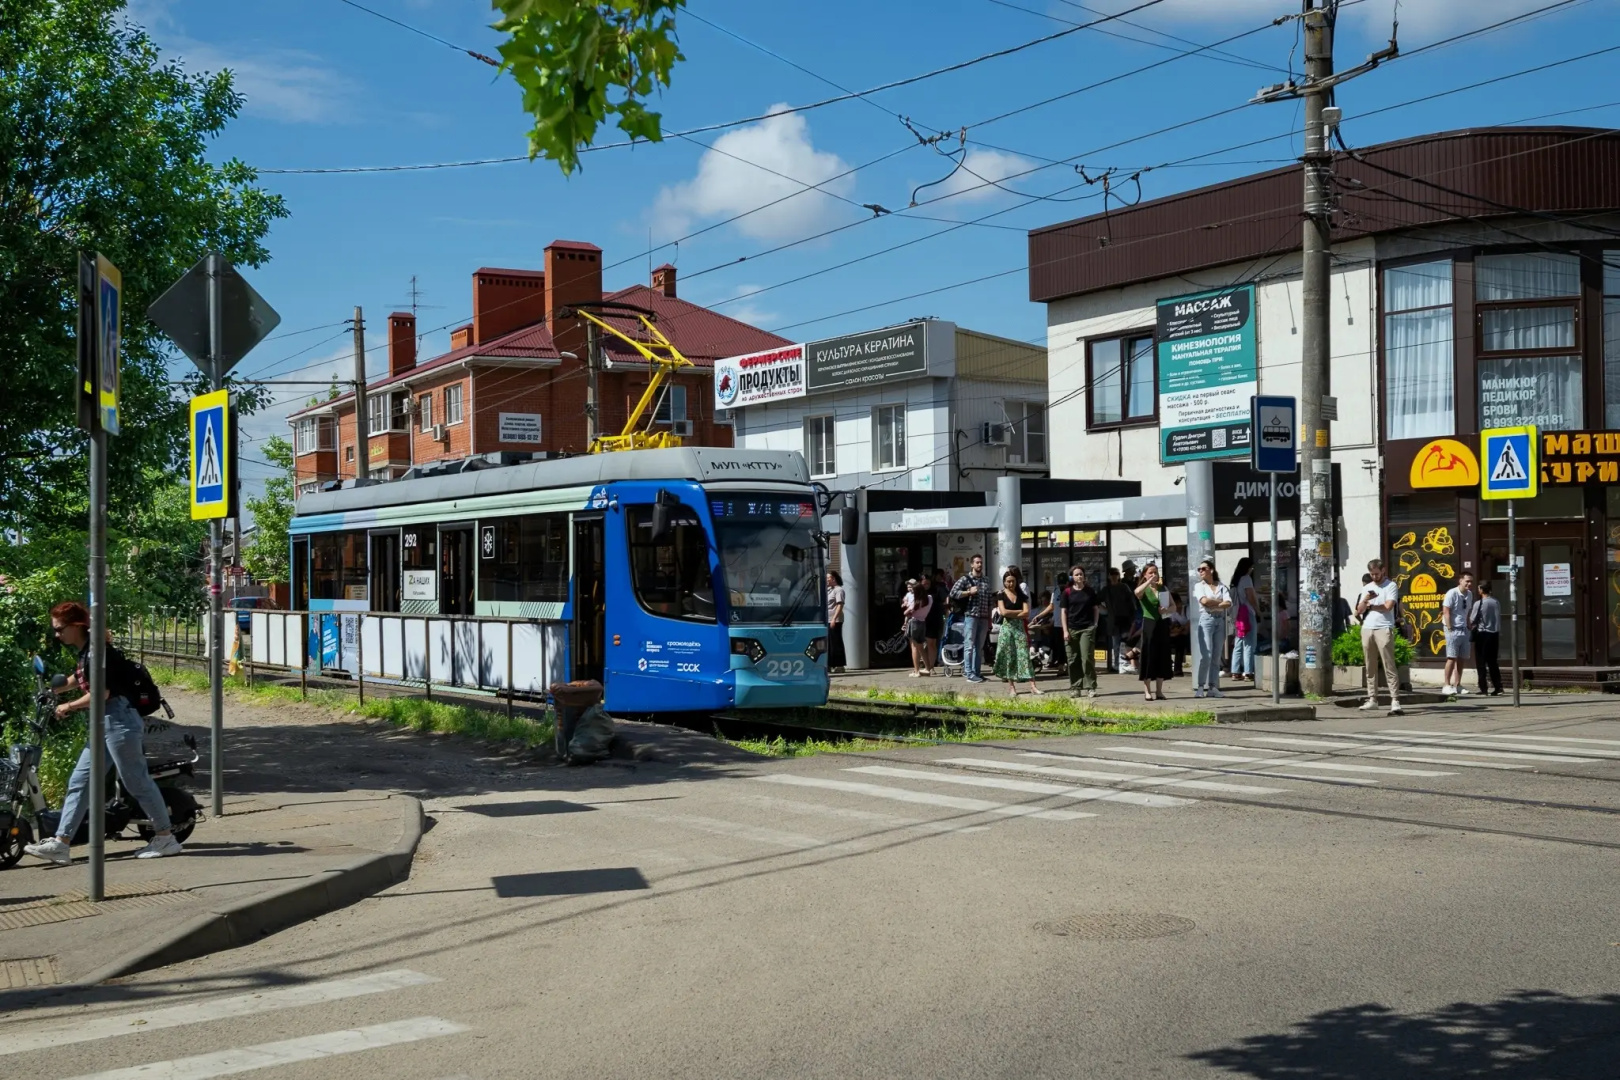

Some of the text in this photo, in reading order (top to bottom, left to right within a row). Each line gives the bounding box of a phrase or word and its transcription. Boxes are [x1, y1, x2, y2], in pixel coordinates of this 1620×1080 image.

[1174, 296, 1232, 317] МАССАЖ
[816, 334, 914, 362] КУЛЬТУРА КЕРАТИНА
[1171, 334, 1242, 353] КИНЕЗИОЛОГИЯ
[740, 348, 802, 367] ФЕРМЕРСКИЕ
[1171, 344, 1242, 360] МАНУАЛЬНАЯ ТЕРАПИЯ
[740, 364, 800, 391] ПРОДУКТЫ
[845, 374, 884, 385] салон красоты
[1482, 377, 1537, 390] МАНИКЮР
[748, 390, 786, 402] дружественных
[1167, 394, 1191, 402] СКИДКА
[1200, 390, 1220, 398] первый
[1482, 390, 1536, 402] ПЕДИКЮР
[1205, 406, 1235, 414] диагностика
[1216, 409, 1250, 419] БЕСПЛАТНО
[1483, 404, 1517, 416] БРОВИ
[1484, 414, 1564, 428] 8 993 322 81 81
[1188, 432, 1206, 440] Дмитрий
[711, 462, 782, 470] МУП «КТТУ»
[1234, 482, 1269, 499] ДИМ
[404, 534, 417, 547] 292
[1402, 594, 1446, 603] ДОМАШНЯЯ
[1409, 601, 1440, 609] КУРИЦА
[767, 660, 804, 677] 292
